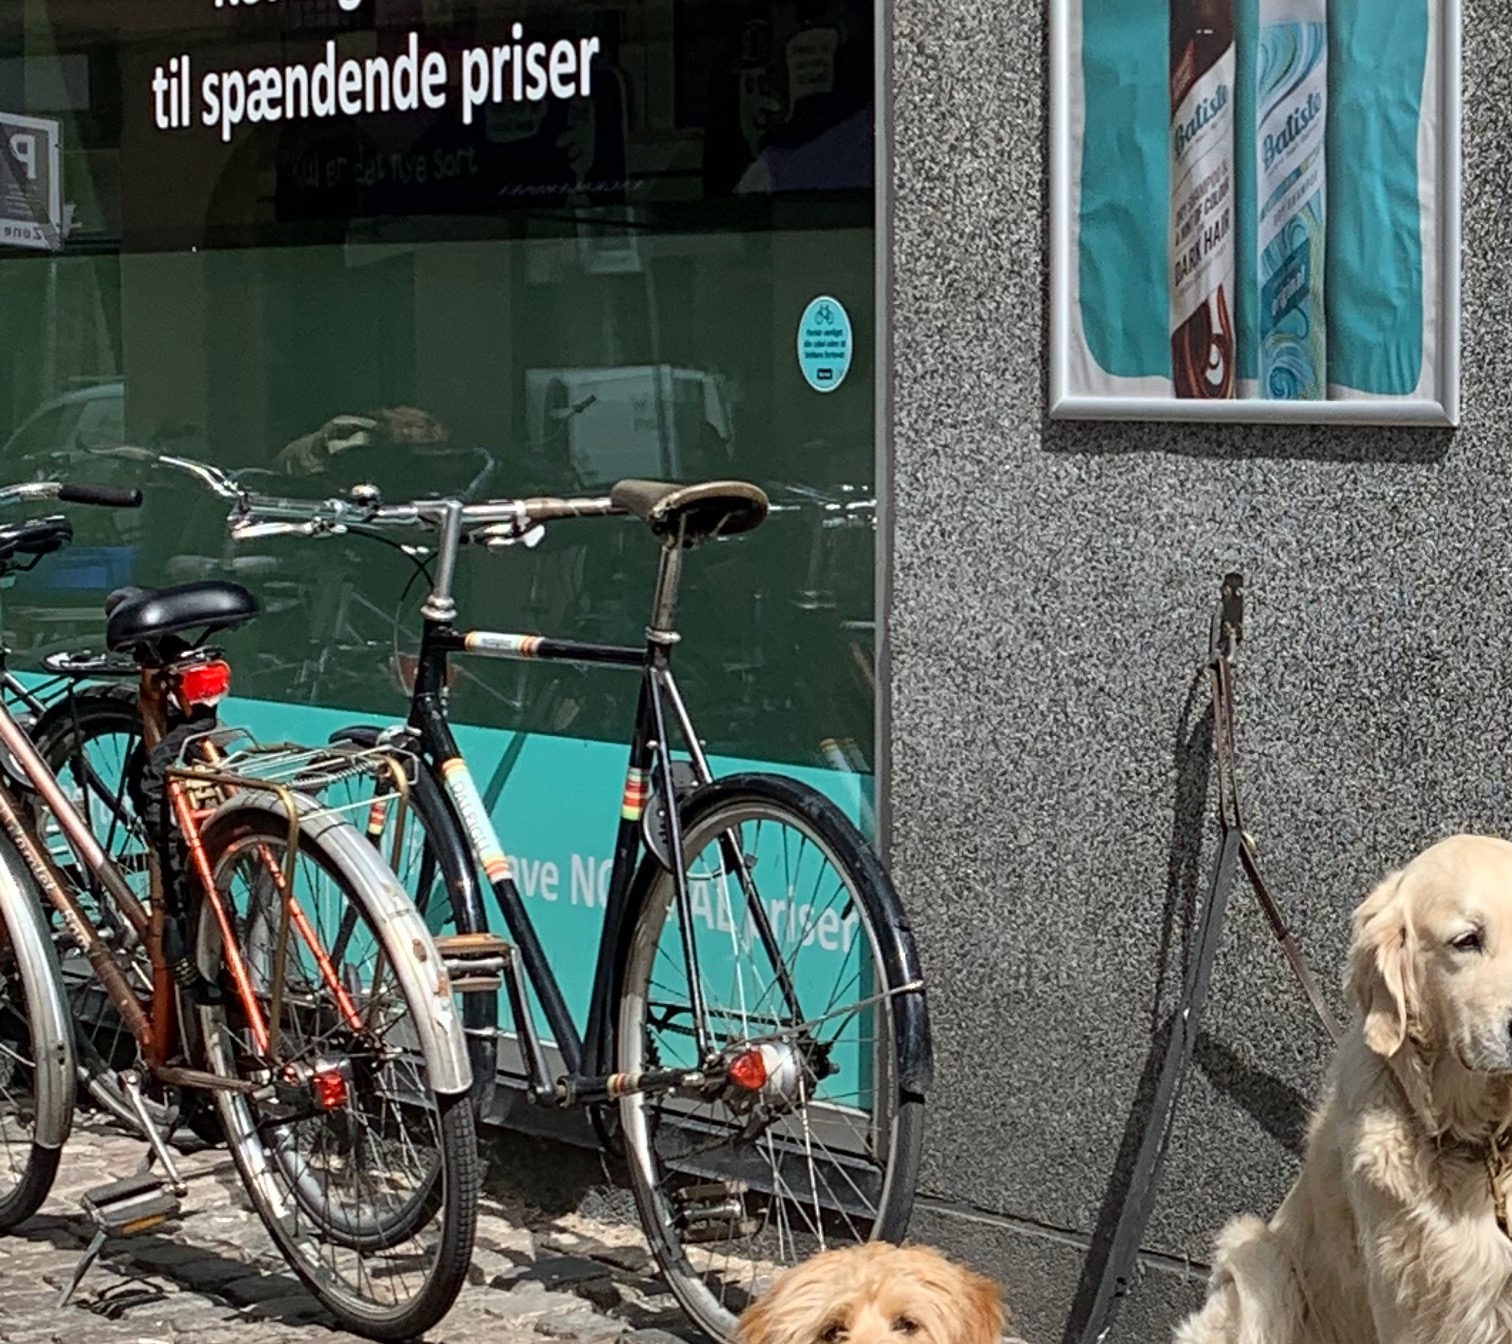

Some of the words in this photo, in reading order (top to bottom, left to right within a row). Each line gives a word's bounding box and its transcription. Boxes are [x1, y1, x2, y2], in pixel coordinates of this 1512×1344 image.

[151, 54, 190, 128] til
[201, 31, 447, 141] spændende
[462, 23, 599, 124] priser
